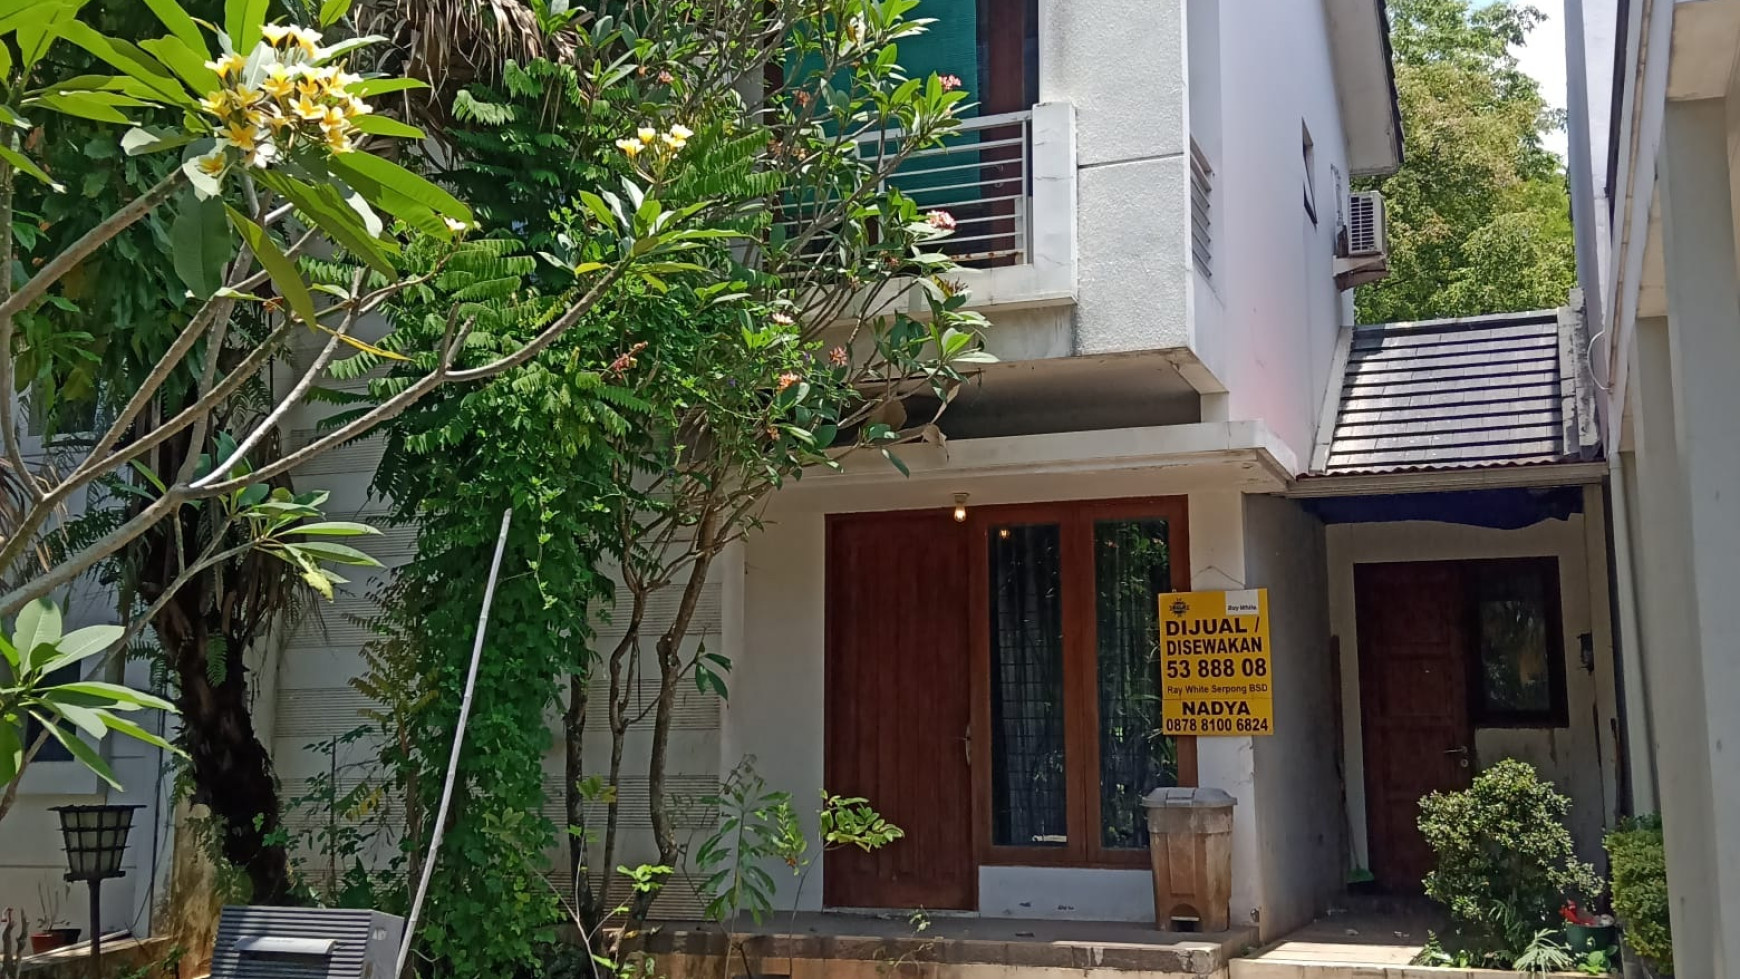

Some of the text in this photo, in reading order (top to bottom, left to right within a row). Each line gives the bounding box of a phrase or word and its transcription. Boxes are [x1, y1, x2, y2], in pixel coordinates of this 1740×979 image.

[1165, 616, 1260, 636] DIJUAL /
[1167, 637, 1262, 656] DISEWAKAN
[1167, 658, 1267, 678] 53 888 08
[1167, 683, 1268, 696] Ray White Serpong BSD
[1182, 701, 1251, 715] NADYA
[1166, 718, 1269, 732] 0878 8100 6824
